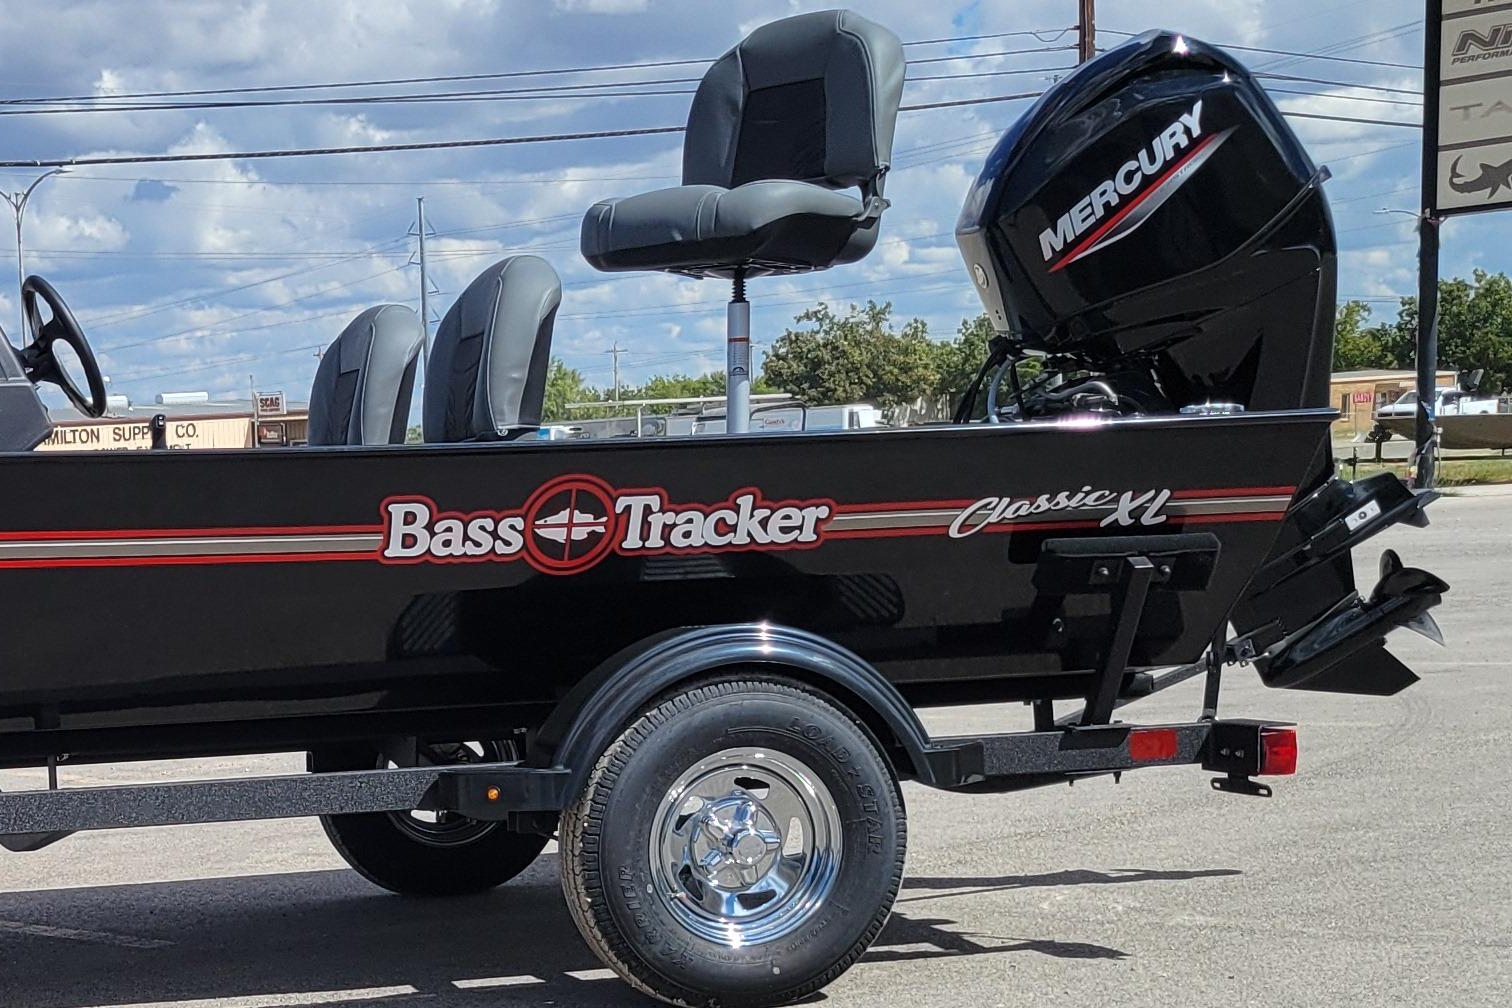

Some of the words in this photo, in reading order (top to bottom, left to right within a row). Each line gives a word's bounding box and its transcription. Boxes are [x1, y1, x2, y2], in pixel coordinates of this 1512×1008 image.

[1038, 99, 1202, 262] MERCURY
[259, 396, 280, 408] SCAG
[42, 427, 101, 446] MILTON
[175, 422, 199, 438] CO.
[383, 502, 525, 558] Bass
[615, 494, 830, 550] Tracker
[948, 485, 1118, 539] Classic
[1099, 488, 1171, 528] XL
[855, 783, 884, 855] STAR
